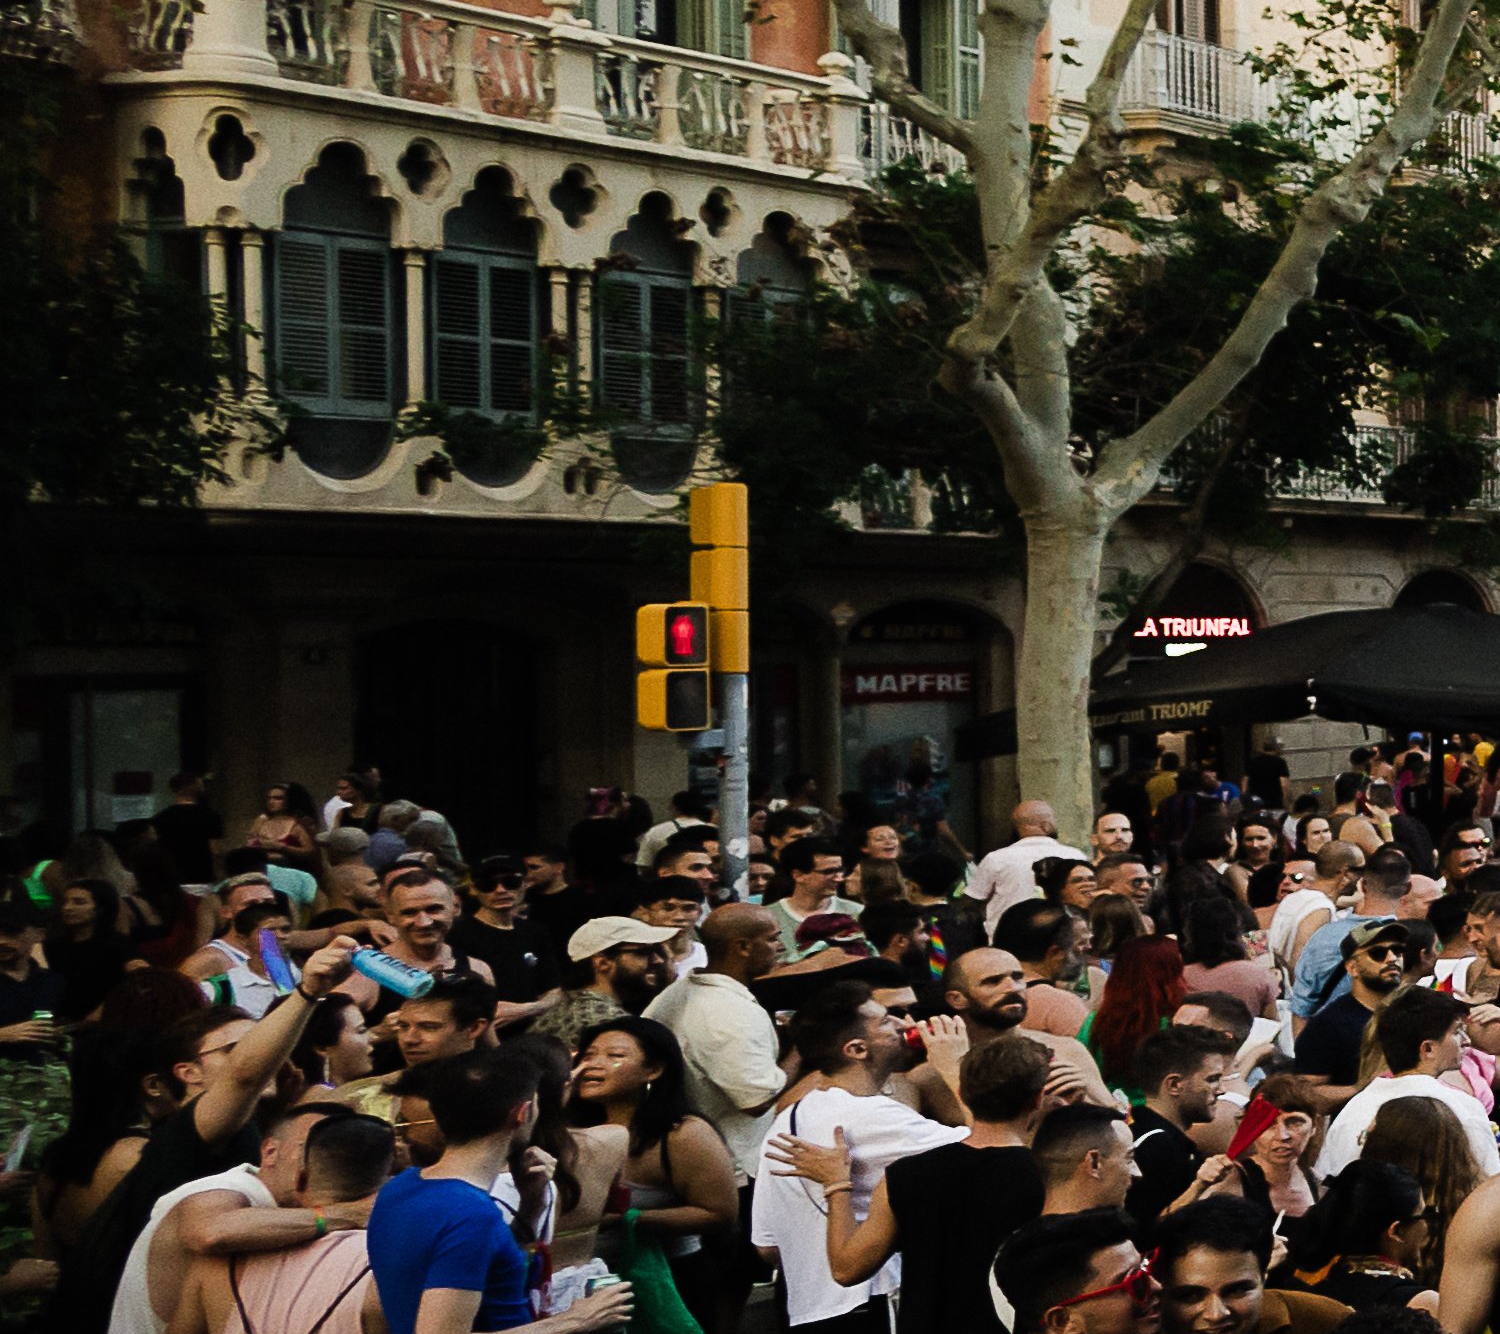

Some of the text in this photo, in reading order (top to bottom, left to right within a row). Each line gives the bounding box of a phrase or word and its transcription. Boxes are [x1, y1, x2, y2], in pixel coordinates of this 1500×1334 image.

[1159, 617, 1252, 637] TRIUNFAL
[856, 673, 970, 693] MAPFRE
[1149, 699, 1213, 720] TRIOMF
